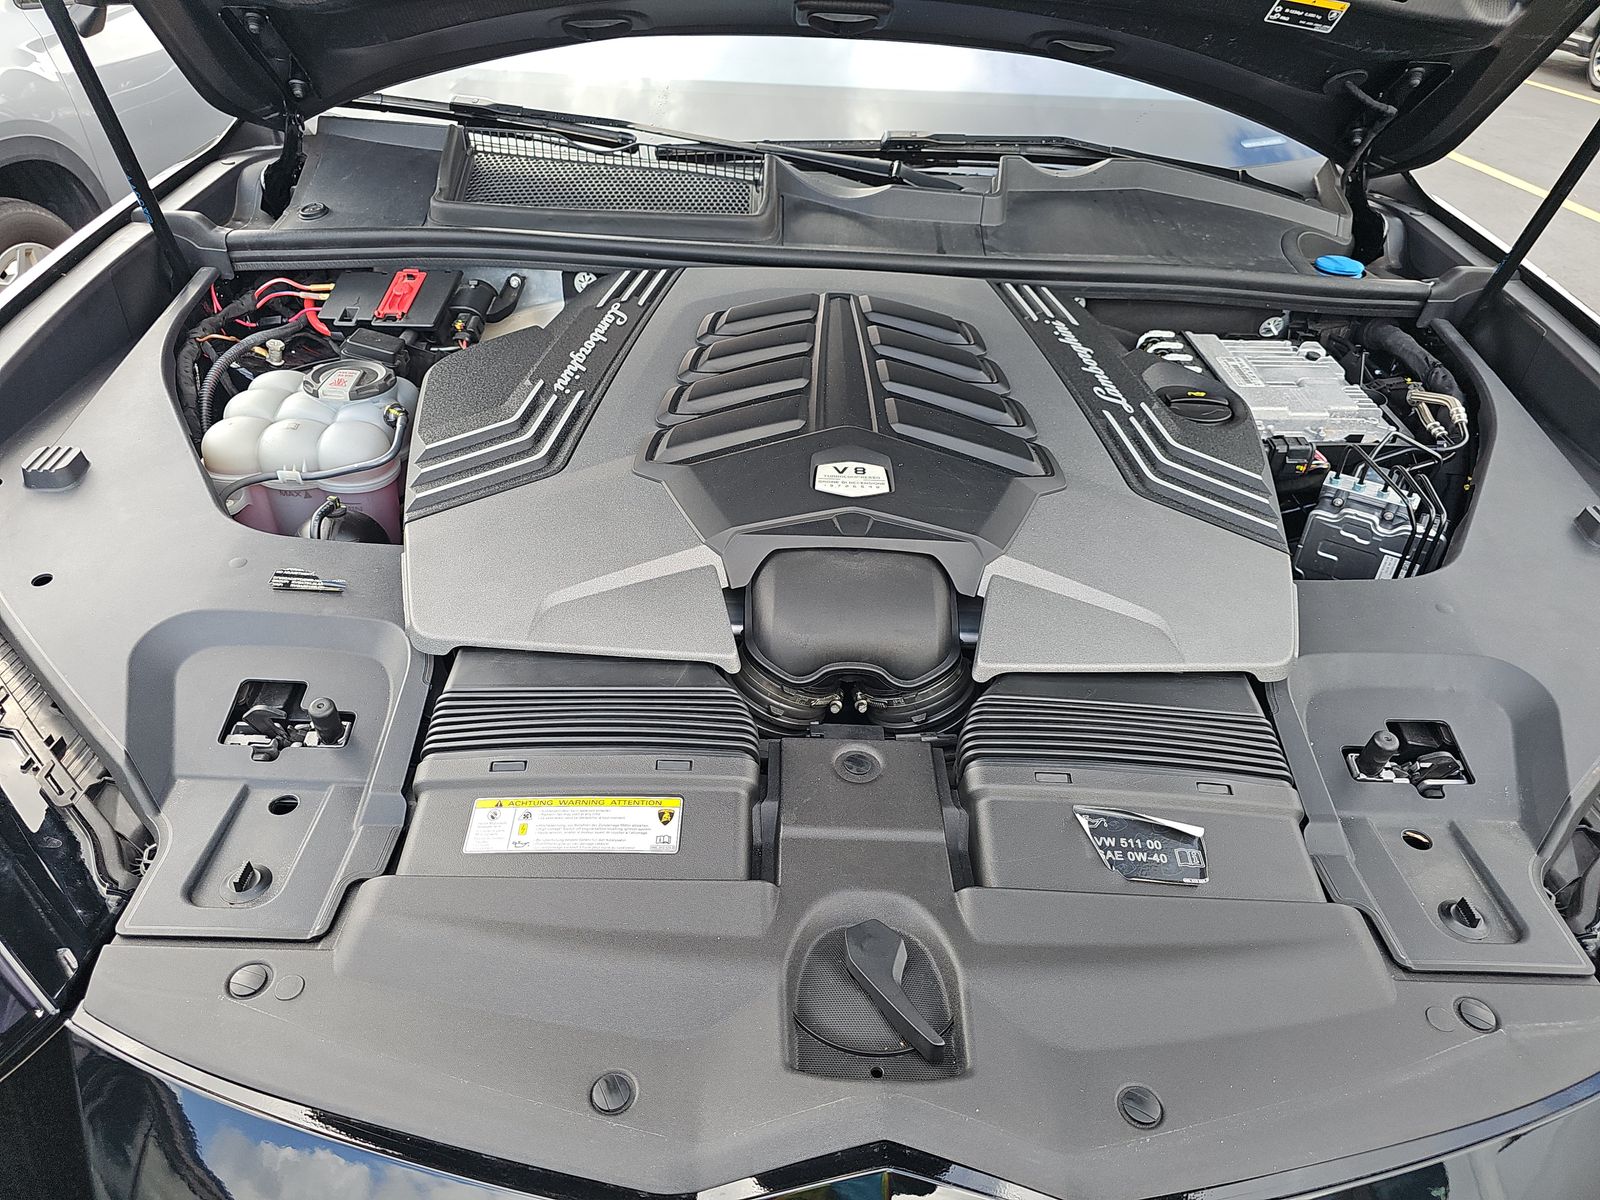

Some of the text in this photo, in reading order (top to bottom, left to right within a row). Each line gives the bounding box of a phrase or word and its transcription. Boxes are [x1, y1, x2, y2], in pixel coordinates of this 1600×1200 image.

[553, 302, 628, 394] Lamborghini
[1043, 318, 1135, 414] Lamborghini
[833, 466, 867, 475] V8
[508, 799, 663, 807] ACHTUNG WARNING ATTENTION
[1094, 836, 1162, 850] VW 511 00
[1127, 851, 1168, 864] 0W-40
